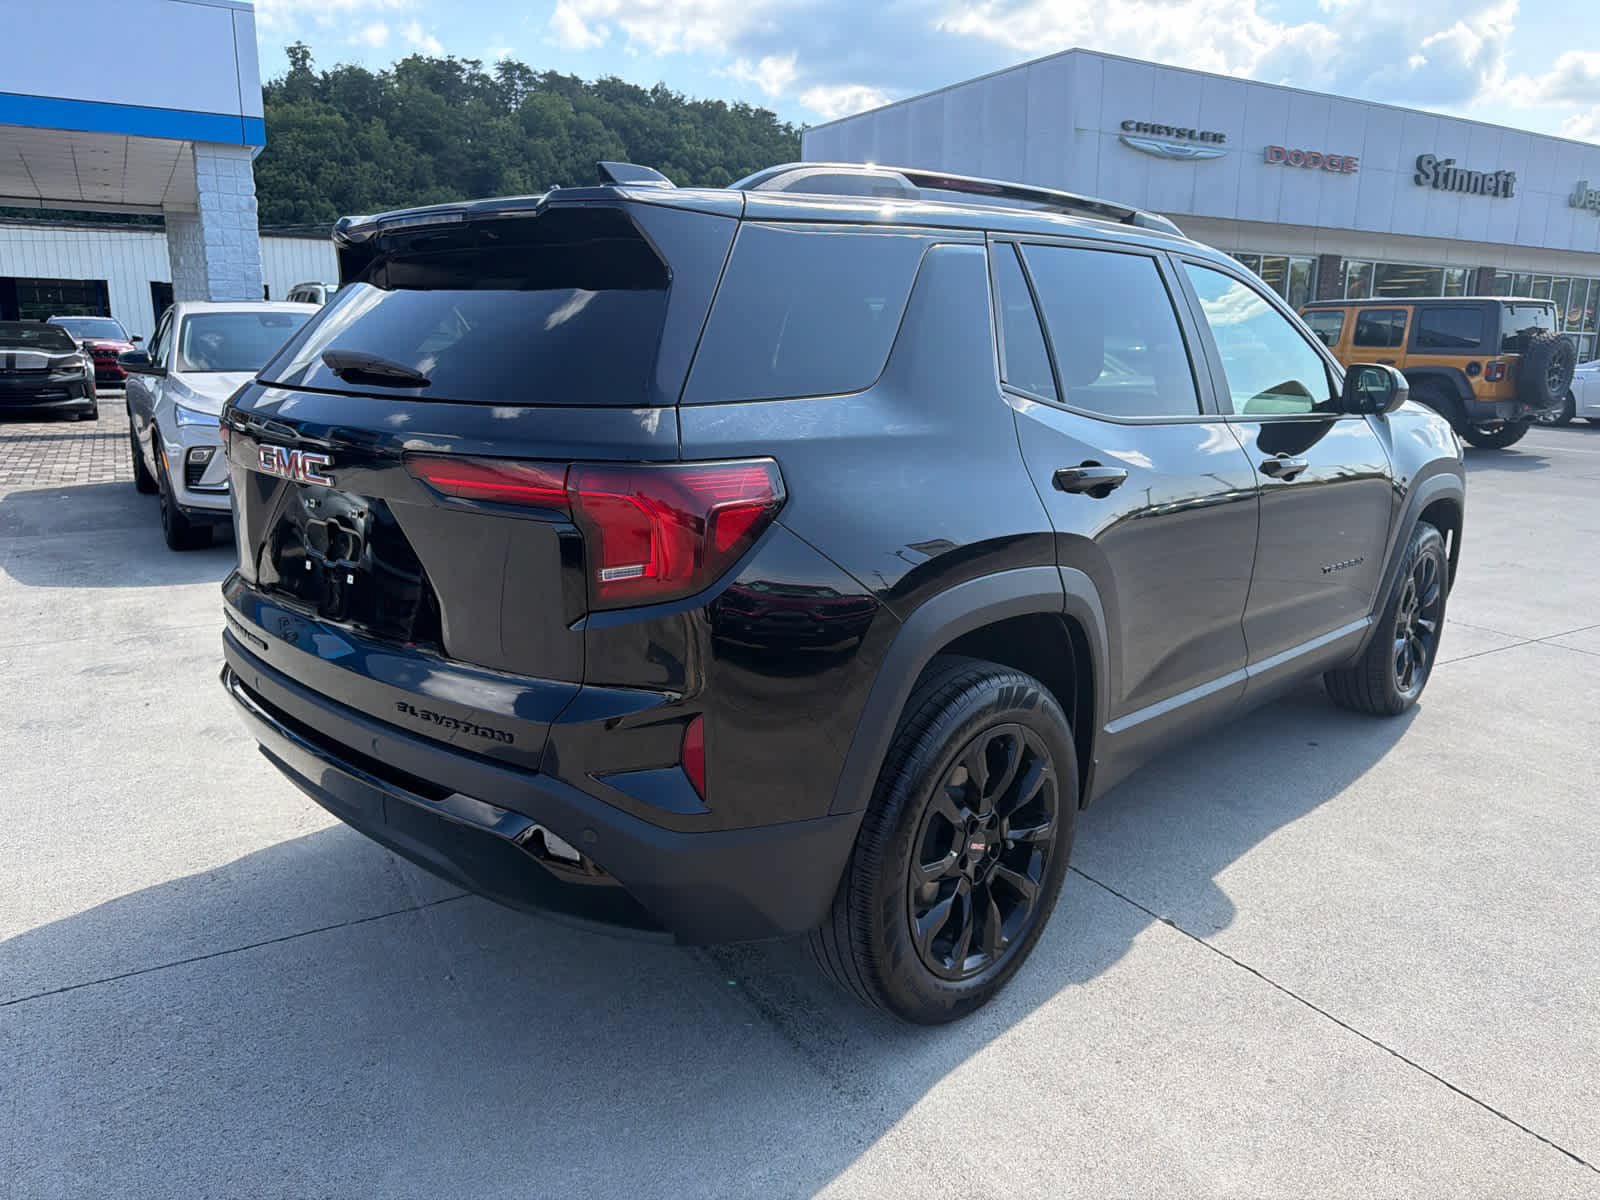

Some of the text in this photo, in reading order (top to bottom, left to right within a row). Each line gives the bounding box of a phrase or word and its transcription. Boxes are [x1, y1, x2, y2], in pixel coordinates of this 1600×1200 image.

[1120, 119, 1226, 144] CHRYSLER
[1264, 145, 1360, 174] DODGE
[1414, 153, 1516, 198] Stinnett
[258, 443, 335, 487] GMC
[396, 702, 514, 744] ELEVATION
